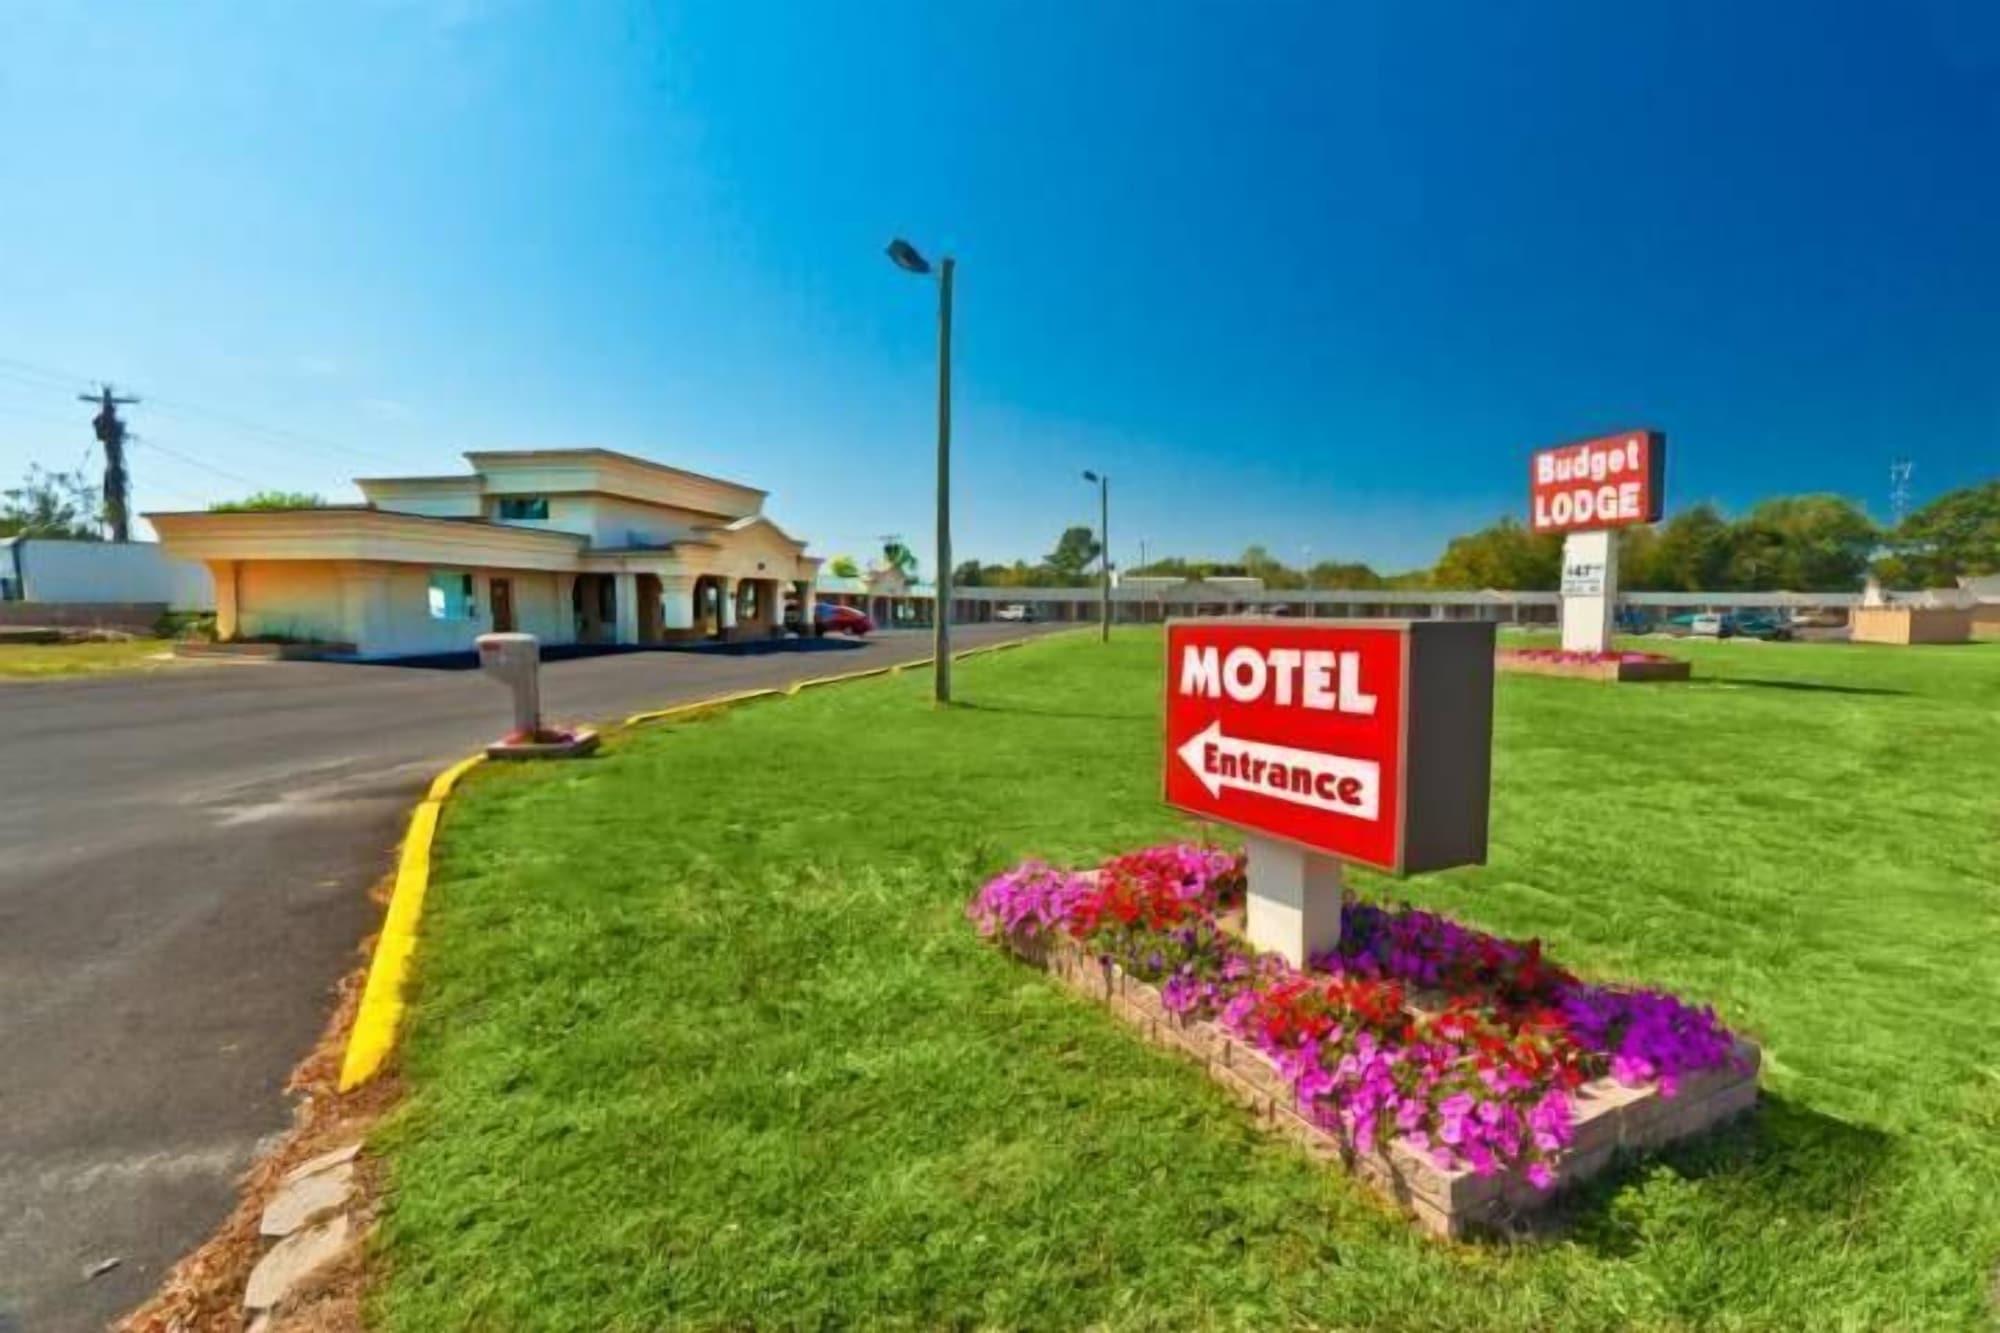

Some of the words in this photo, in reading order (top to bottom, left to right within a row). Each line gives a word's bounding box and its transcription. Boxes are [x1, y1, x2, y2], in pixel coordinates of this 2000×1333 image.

[1535, 483, 1640, 527] LODGE
[1179, 645, 1377, 715] MOTEL
[1203, 742, 1363, 806] Entrance
